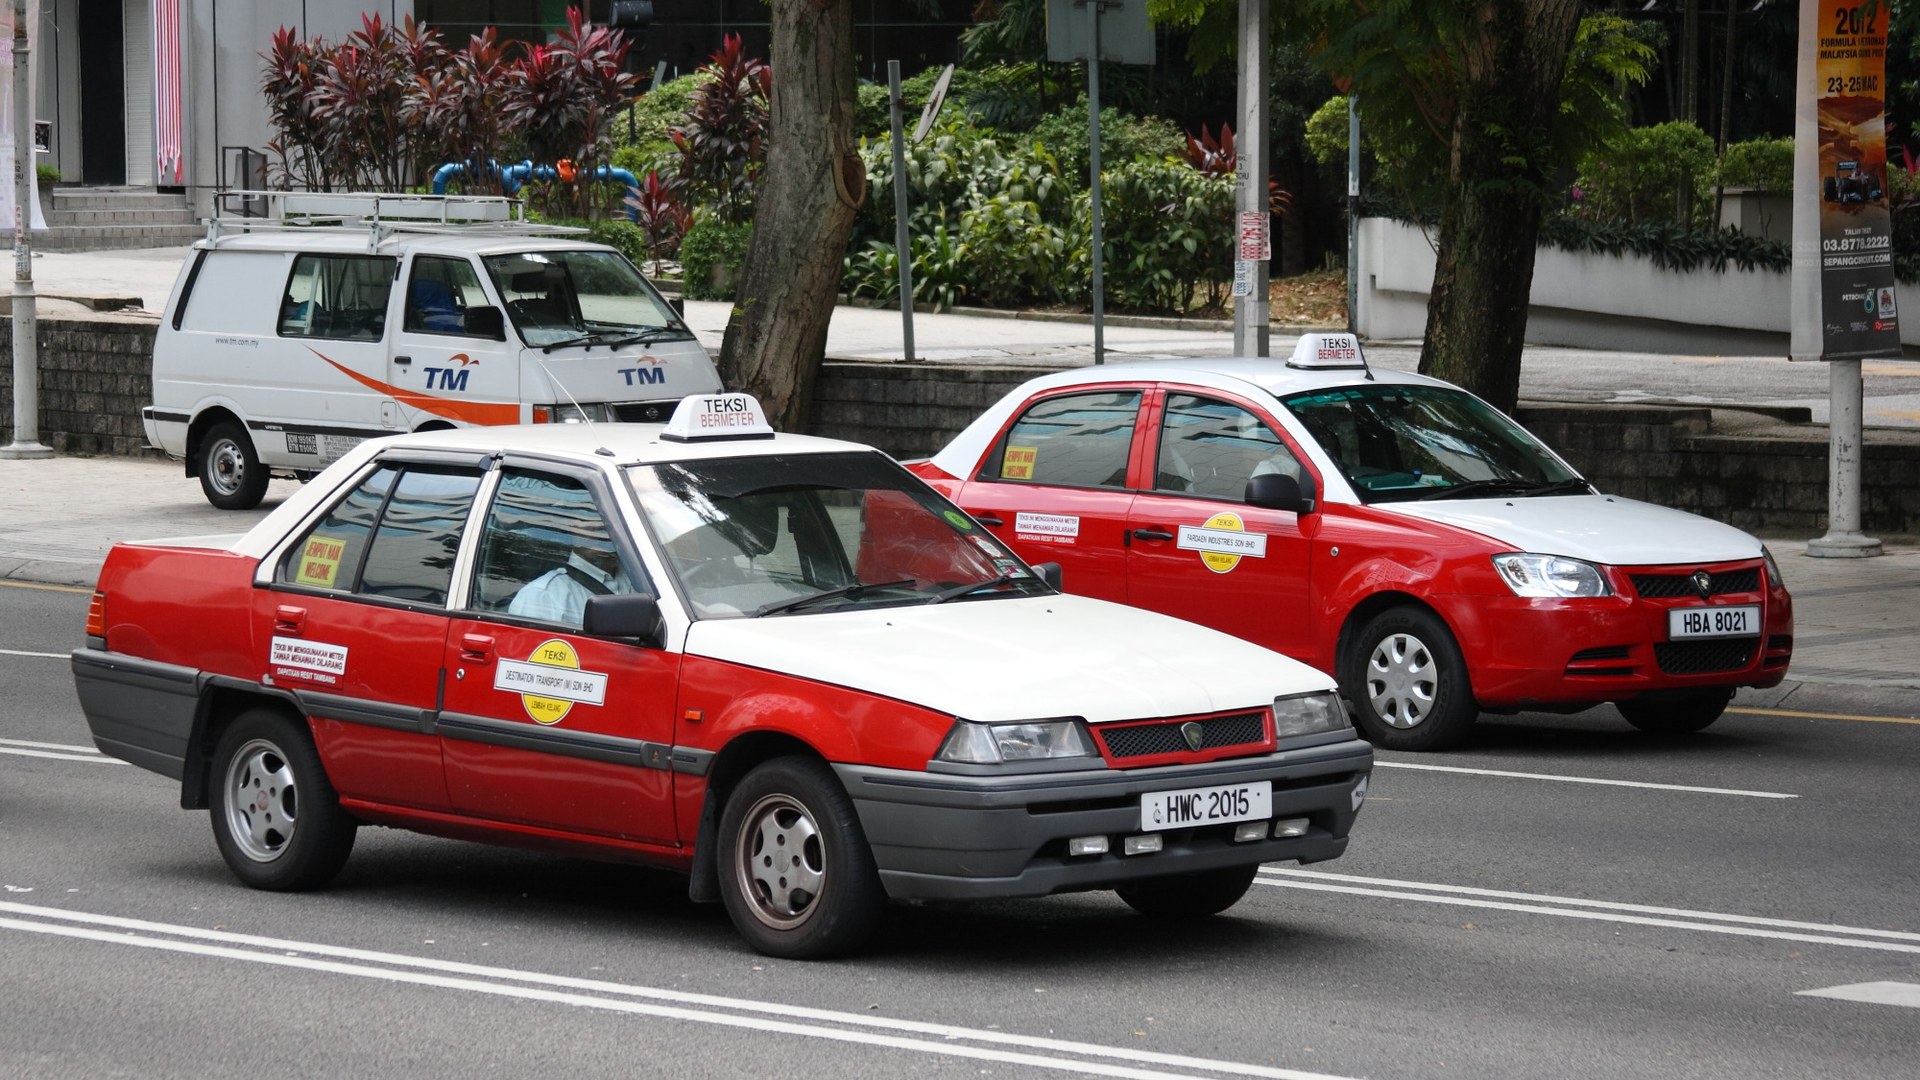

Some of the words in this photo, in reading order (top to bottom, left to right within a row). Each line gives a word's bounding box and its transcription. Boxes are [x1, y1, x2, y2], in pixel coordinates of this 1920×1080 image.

[1821, 37, 1856, 48] FORMULA
[1820, 49, 1858, 60] MALAYSIA
[1828, 76, 1861, 92] 23-25
[1861, 75, 1878, 92] MAC
[1824, 236, 1889, 251] 03.8778.2222
[1824, 254, 1890, 266] SEPANGCIRCUIT.COM
[216, 337, 259, 348] www.tm.com.my
[1322, 338, 1351, 349] TEKSI
[1318, 349, 1356, 359] BERMETER
[423, 367, 470, 391] TM
[617, 367, 666, 386] TM
[704, 398, 747, 413] TEKSI
[701, 412, 754, 427] BERMETER
[1216, 519, 1234, 527] TEKSI
[1187, 533, 1207, 543] FARDAEN
[1208, 537, 1233, 546] INDUSTRIES
[306, 542, 328, 558] JEMPUT
[326, 544, 342, 561] NAIK
[304, 561, 332, 580] WELCOME
[1684, 612, 1711, 633] HBA
[1715, 611, 1746, 632] 8021
[294, 646, 328, 658] MENGGUNAKAN
[328, 652, 344, 660] METER
[544, 650, 566, 662] TEKSI
[273, 652, 290, 661] TAWAR
[291, 654, 316, 665] MENAWAR
[316, 658, 343, 670] DILARANG
[277, 668, 300, 677] DAPATKAN
[300, 671, 313, 679] RESIT
[314, 673, 336, 684] TAMBANG
[506, 670, 534, 683] DESTINATION
[536, 674, 563, 687] TRANSPORT
[564, 679, 572, 690] (M)
[572, 680, 582, 691] SDN
[583, 682, 593, 693] BHD
[531, 701, 546, 710] LEMBAH
[546, 702, 561, 712] KELANG
[1166, 793, 1203, 823] HWC
[1208, 788, 1249, 819] 2015
